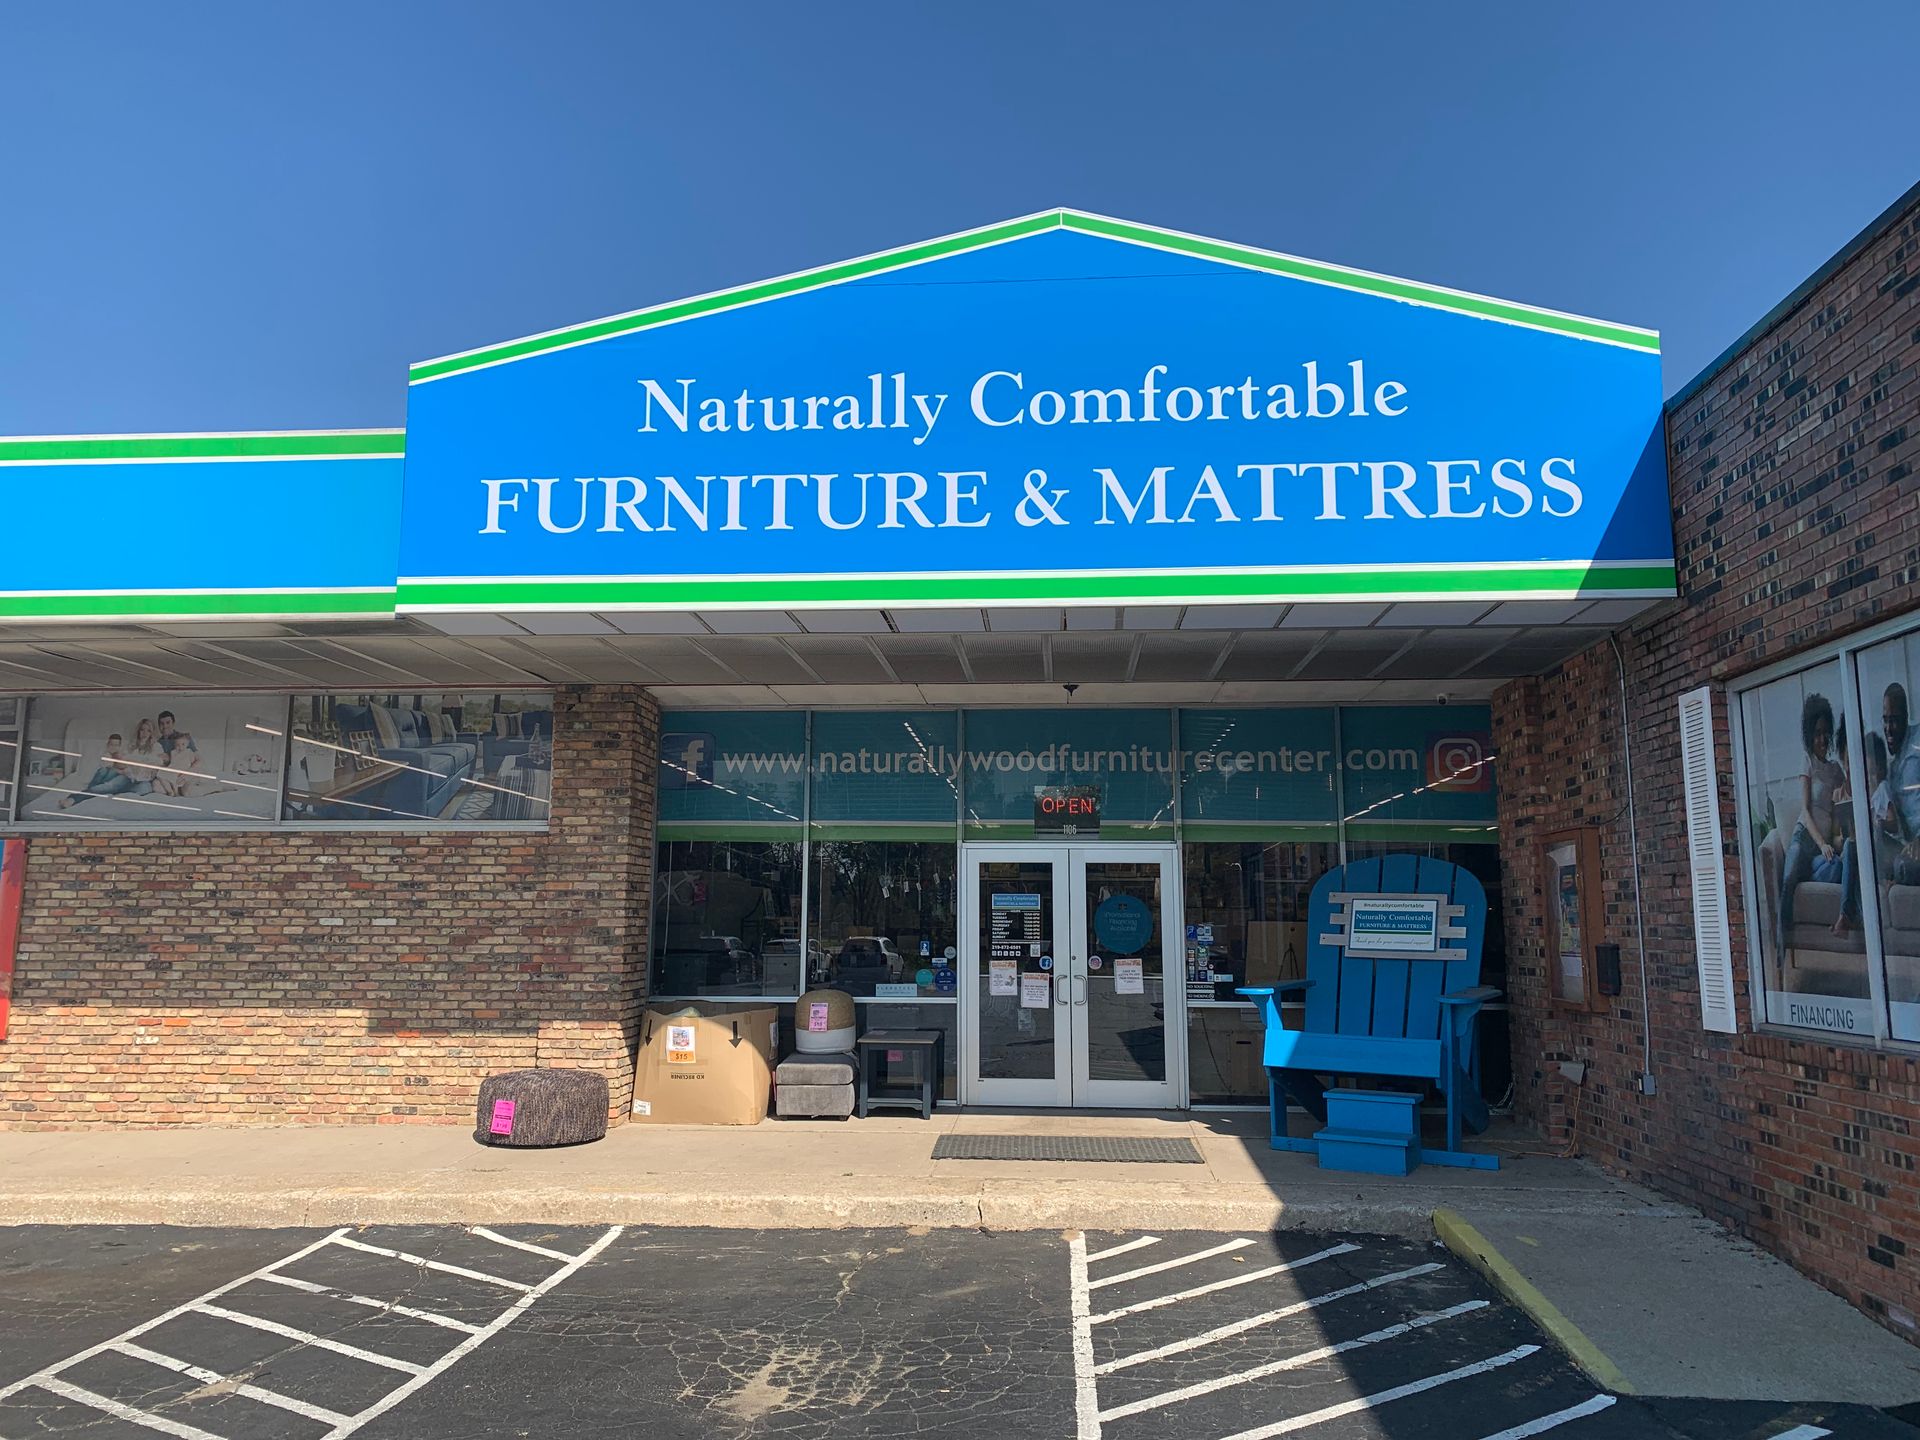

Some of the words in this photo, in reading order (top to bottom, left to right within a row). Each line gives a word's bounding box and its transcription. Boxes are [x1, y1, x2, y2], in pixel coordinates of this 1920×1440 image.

[638, 373, 947, 445] Naturally
[971, 360, 1407, 426] Comfortable
[479, 472, 990, 533] FURNITURE
[1015, 470, 1069, 526] &
[1094, 458, 1582, 524] MATTRESS
[722, 743, 1418, 779] www.naturallywoodfurniturecenter.com
[1041, 796, 1093, 815] OPEN
[1063, 824, 1077, 835] 1106
[1356, 913, 1387, 922] Naturally
[1389, 913, 1432, 922] Comfortable
[1790, 1004, 1854, 1030] FINANCING
